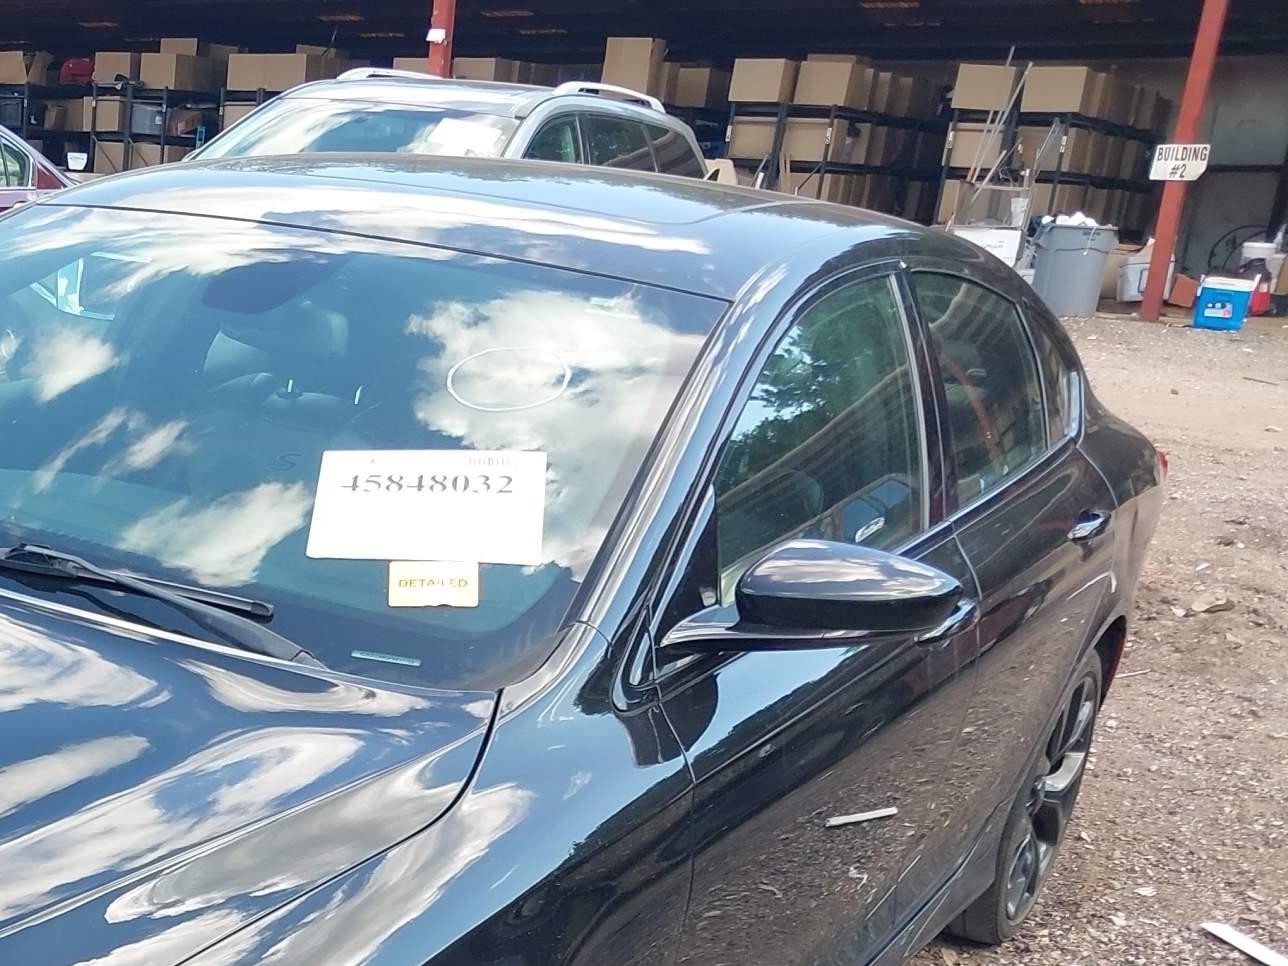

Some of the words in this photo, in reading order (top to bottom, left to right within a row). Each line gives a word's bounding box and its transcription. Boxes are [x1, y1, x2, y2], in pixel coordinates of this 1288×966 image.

[1157, 146, 1209, 161] BUILDING
[1169, 164, 1187, 178] #2
[341, 474, 512, 493] 45848032
[398, 579, 468, 587] DETAILED
